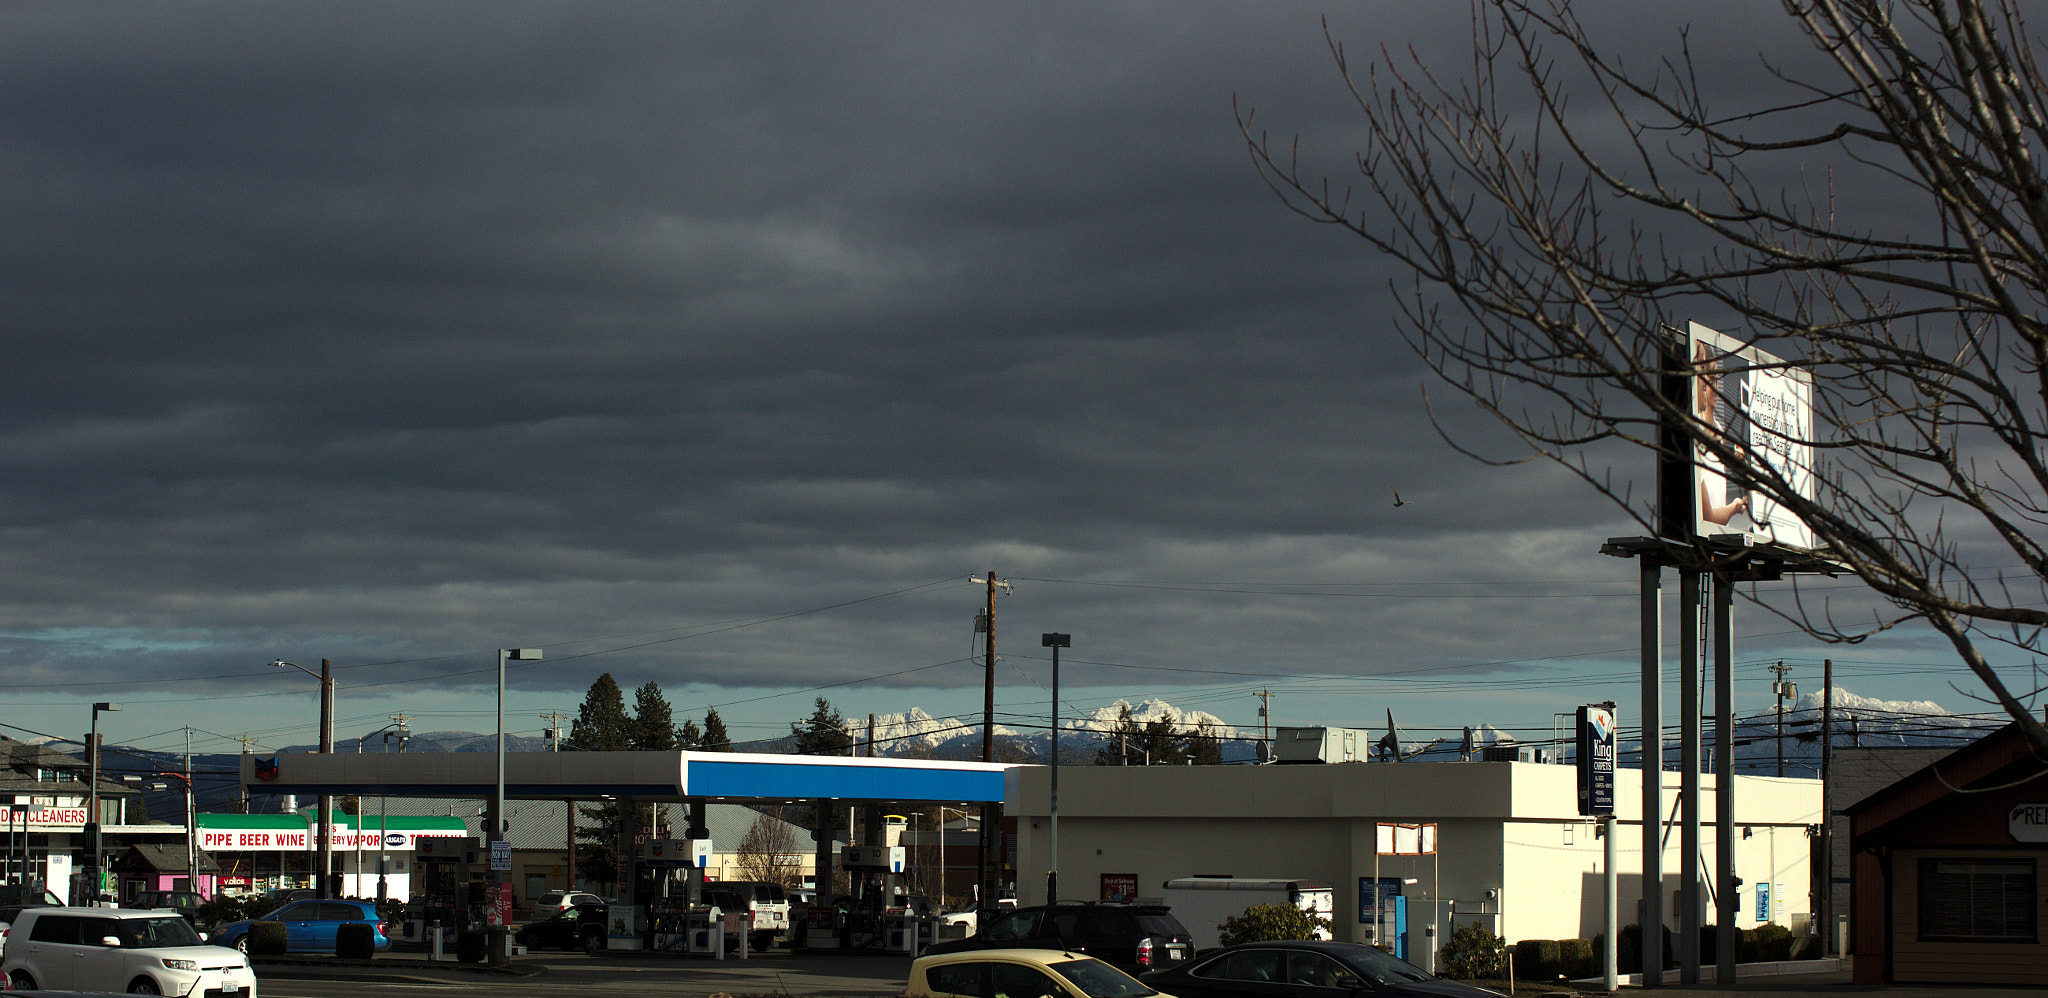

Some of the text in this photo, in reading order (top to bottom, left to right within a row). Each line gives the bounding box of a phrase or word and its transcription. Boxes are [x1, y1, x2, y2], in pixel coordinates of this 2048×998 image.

[1594, 739, 1612, 761] King
[29, 809, 85, 823] CLEANERS
[205, 834, 305, 846] PIPE BEER WINE
[314, 836, 345, 845] GERY
[347, 834, 380, 846] VAPOR
[675, 842, 683, 851] 12
[872, 849, 881, 857] 10
